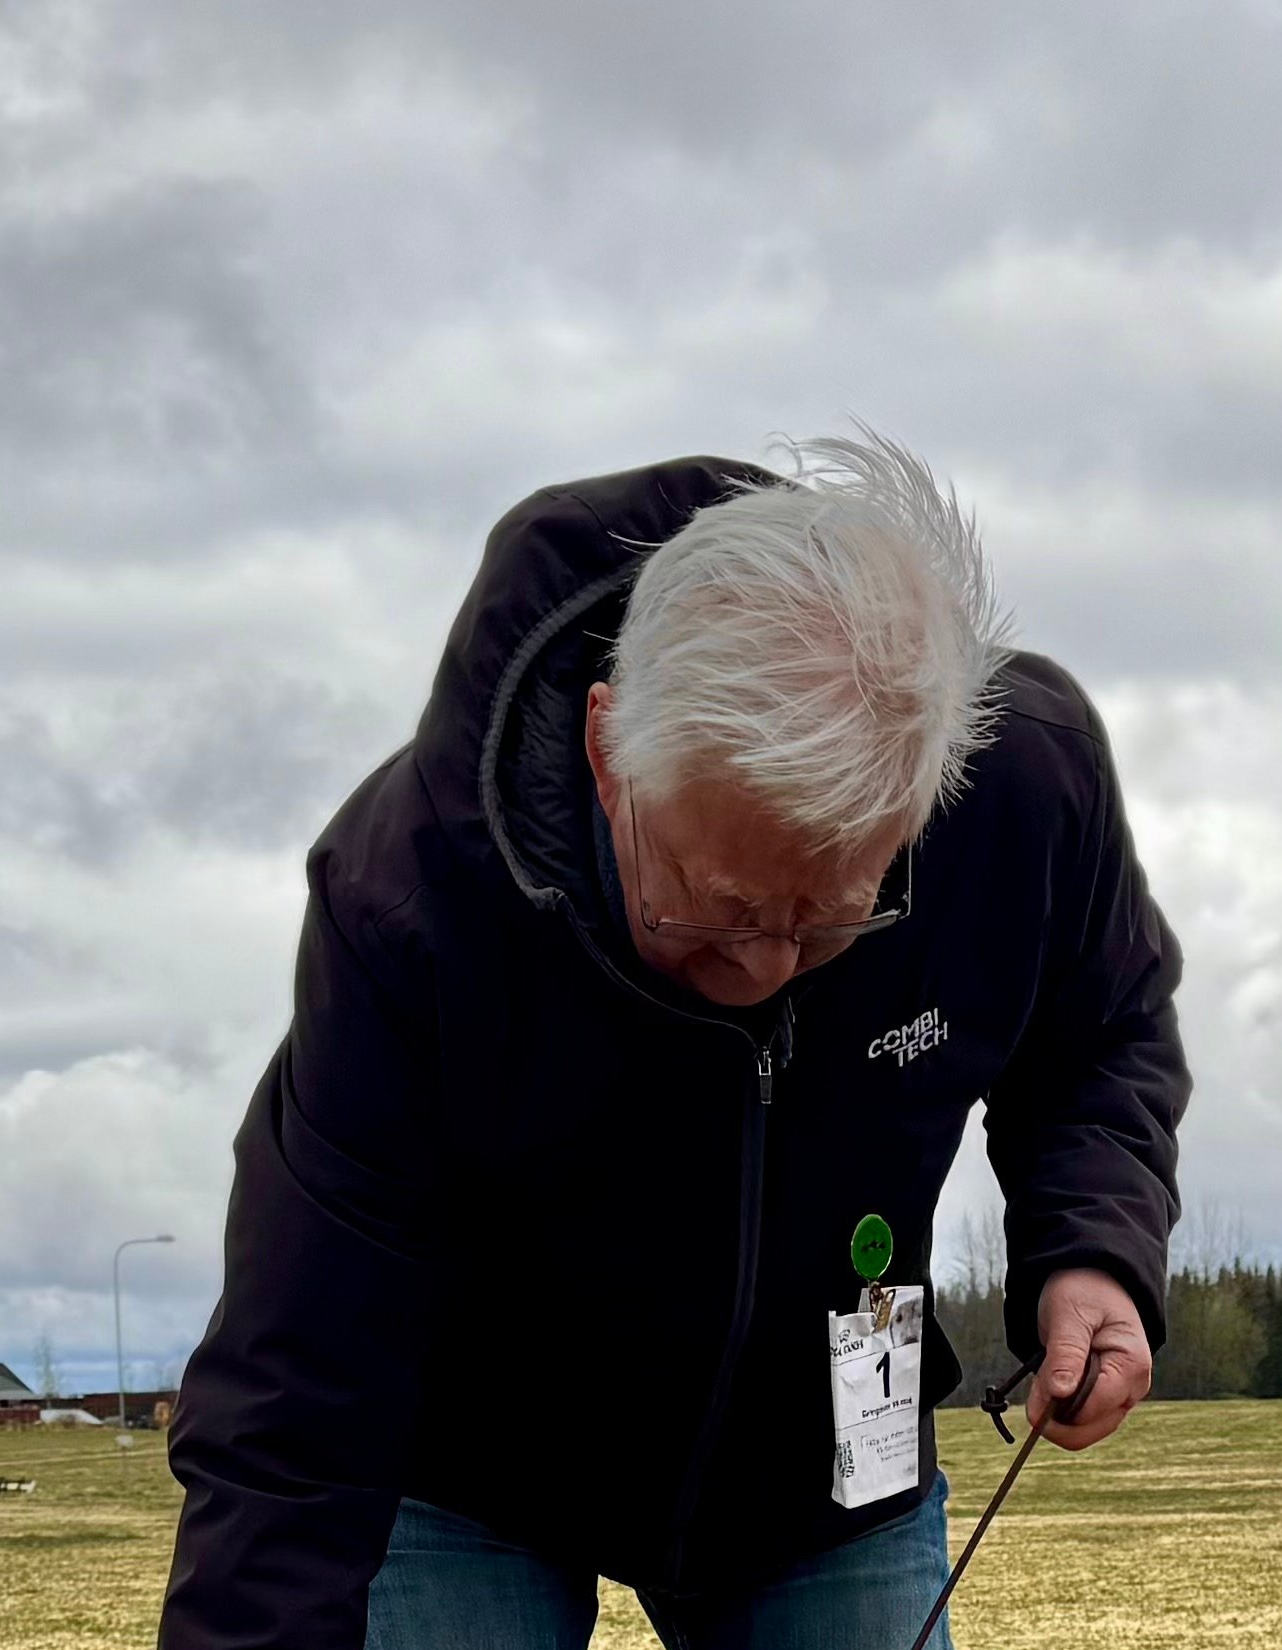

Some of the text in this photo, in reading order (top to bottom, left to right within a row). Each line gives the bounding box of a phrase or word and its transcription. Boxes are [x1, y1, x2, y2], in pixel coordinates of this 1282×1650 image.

[868, 1007, 938, 1058] COMBI
[892, 1021, 948, 1067] TECH
[876, 1351, 890, 1398] 1
